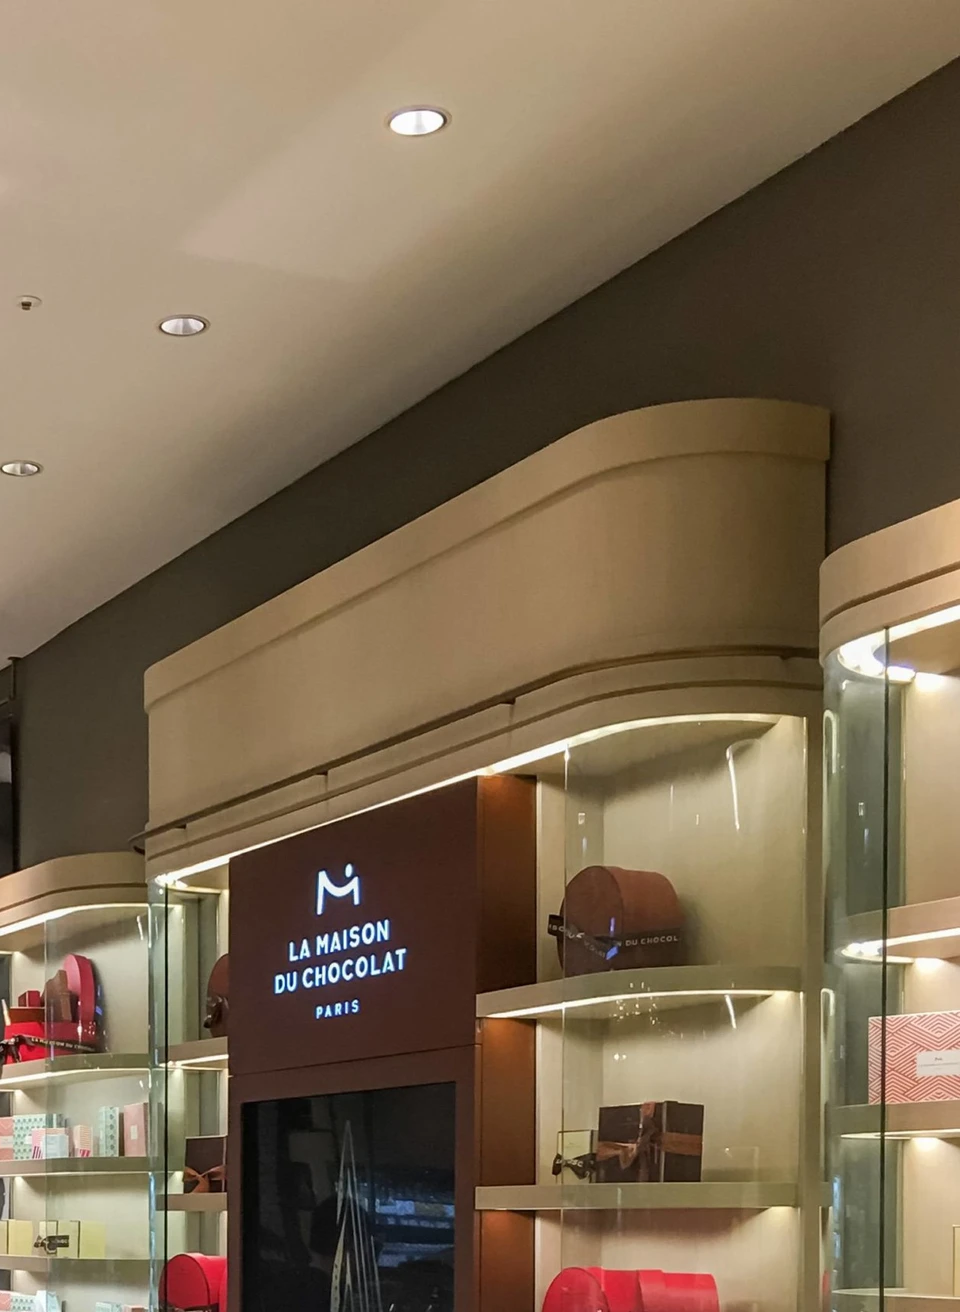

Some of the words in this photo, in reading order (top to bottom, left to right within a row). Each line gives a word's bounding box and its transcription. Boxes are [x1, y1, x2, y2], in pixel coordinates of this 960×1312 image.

[289, 939, 311, 962] LA
[316, 919, 389, 956] MAISON
[625, 937, 638, 947] DU
[274, 971, 298, 994] DU
[302, 948, 407, 988] CHOCOLAT
[316, 999, 359, 1019] PARIS
